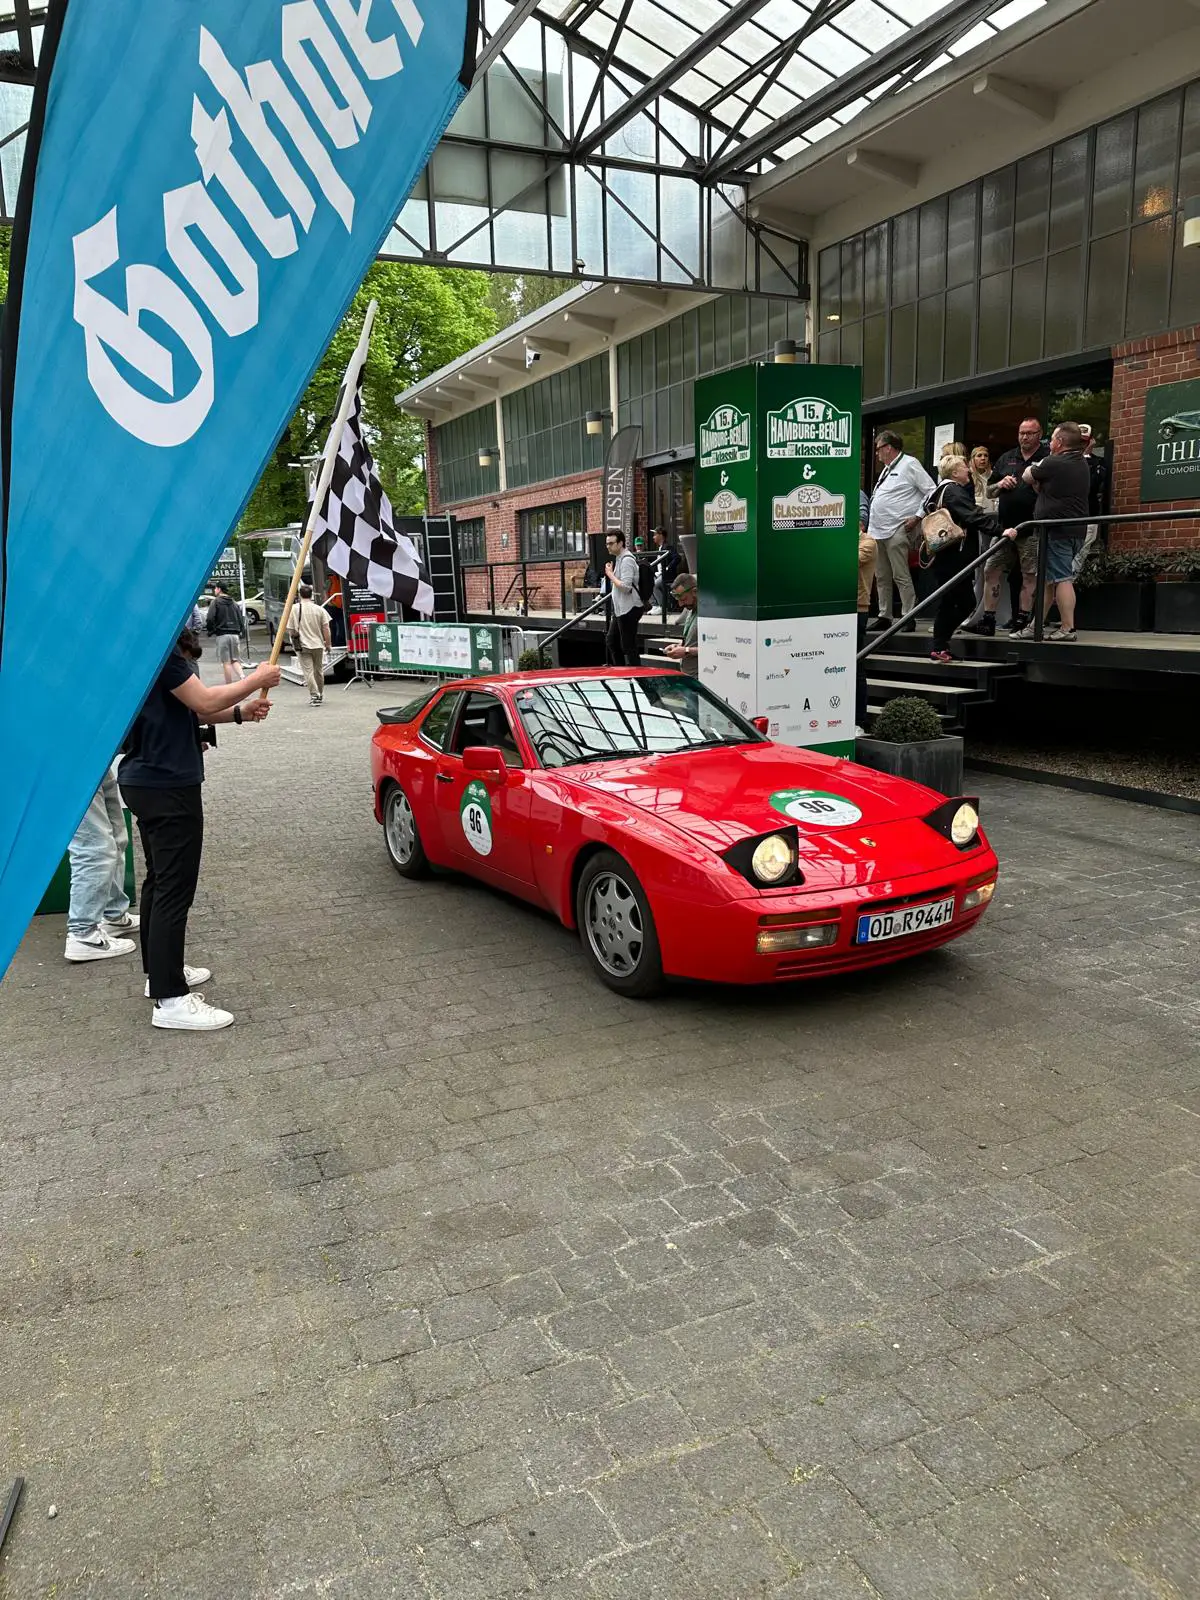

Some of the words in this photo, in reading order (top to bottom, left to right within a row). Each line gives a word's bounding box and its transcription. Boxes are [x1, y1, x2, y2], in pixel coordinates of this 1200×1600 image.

[719, 411, 730, 427] 15.
[802, 404, 819, 419] 15.
[770, 415, 849, 445] HAMBURG-BERLIN
[795, 444, 831, 456] klassik
[720, 470, 729, 486] &
[803, 463, 817, 480] &
[606, 467, 625, 530] IESEN
[705, 508, 726, 523] CLASSIC
[775, 503, 811, 518] CLASSIC
[812, 502, 843, 517] TROPHY
[795, 519, 823, 527] HAMBURG
[798, 800, 836, 814] 96
[469, 807, 482, 834] 96
[870, 917, 893, 938] OD
